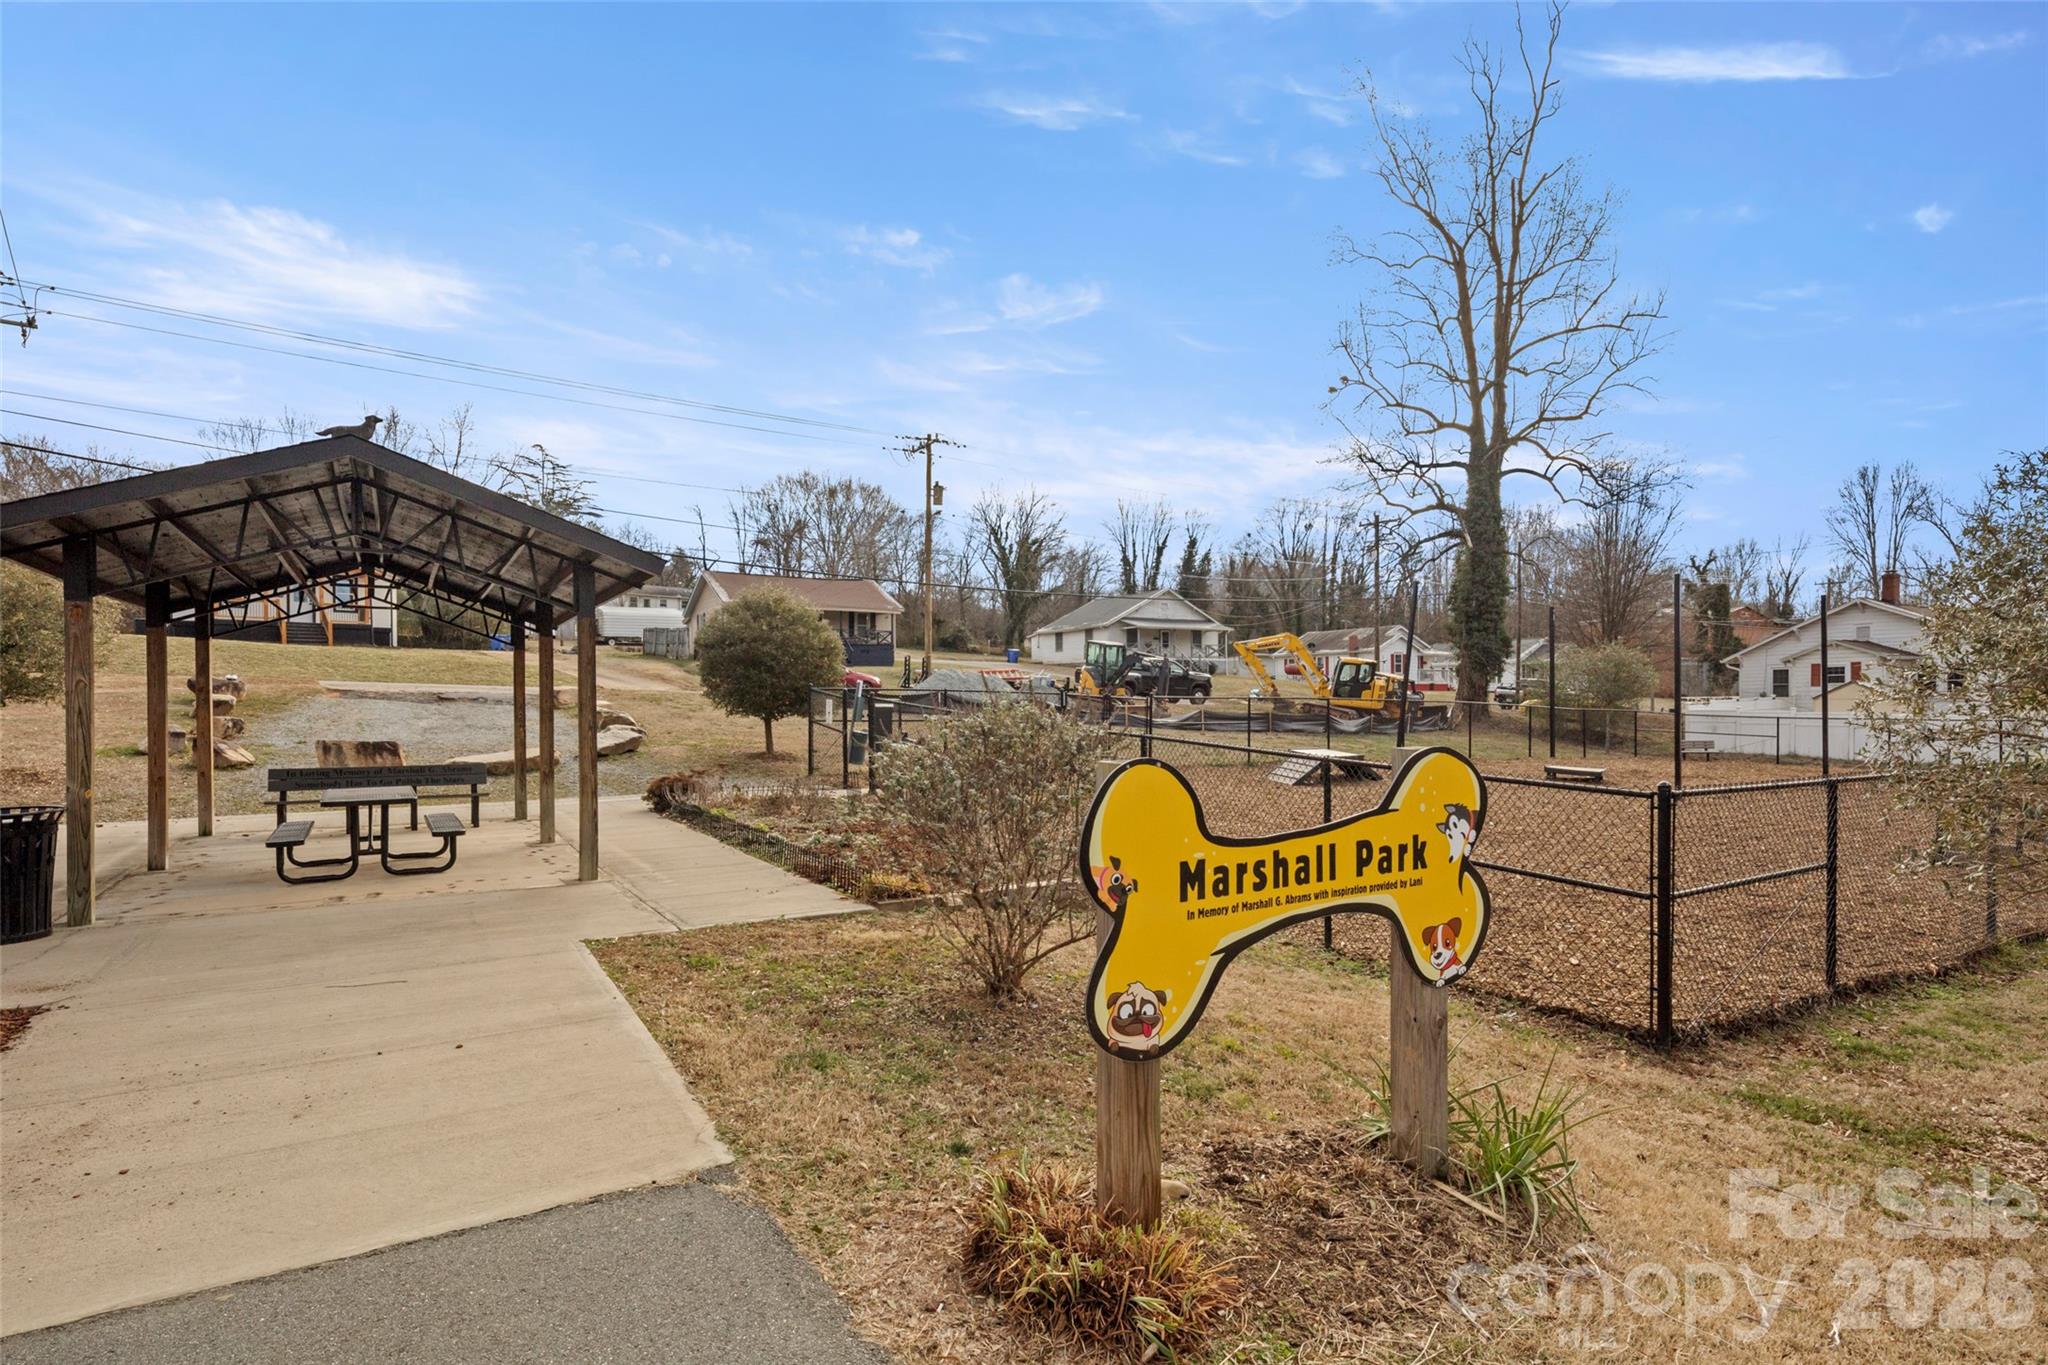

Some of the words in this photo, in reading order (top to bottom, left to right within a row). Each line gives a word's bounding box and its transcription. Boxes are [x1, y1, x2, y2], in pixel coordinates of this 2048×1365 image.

[1179, 844, 1336, 903] Marshall
[1355, 834, 1427, 877] Park
[1187, 910, 1195, 920] In
[1198, 906, 1229, 918] Memory
[1231, 902, 1239, 913] of
[1241, 897, 1273, 911] Marshall
[1275, 896, 1284, 906] G.
[1285, 892, 1312, 904] Abrams
[1313, 889, 1329, 900] with
[1331, 884, 1367, 898] inspiration
[1369, 881, 1398, 893] provided
[1400, 879, 1407, 889] by
[1409, 876, 1423, 887] Lani
